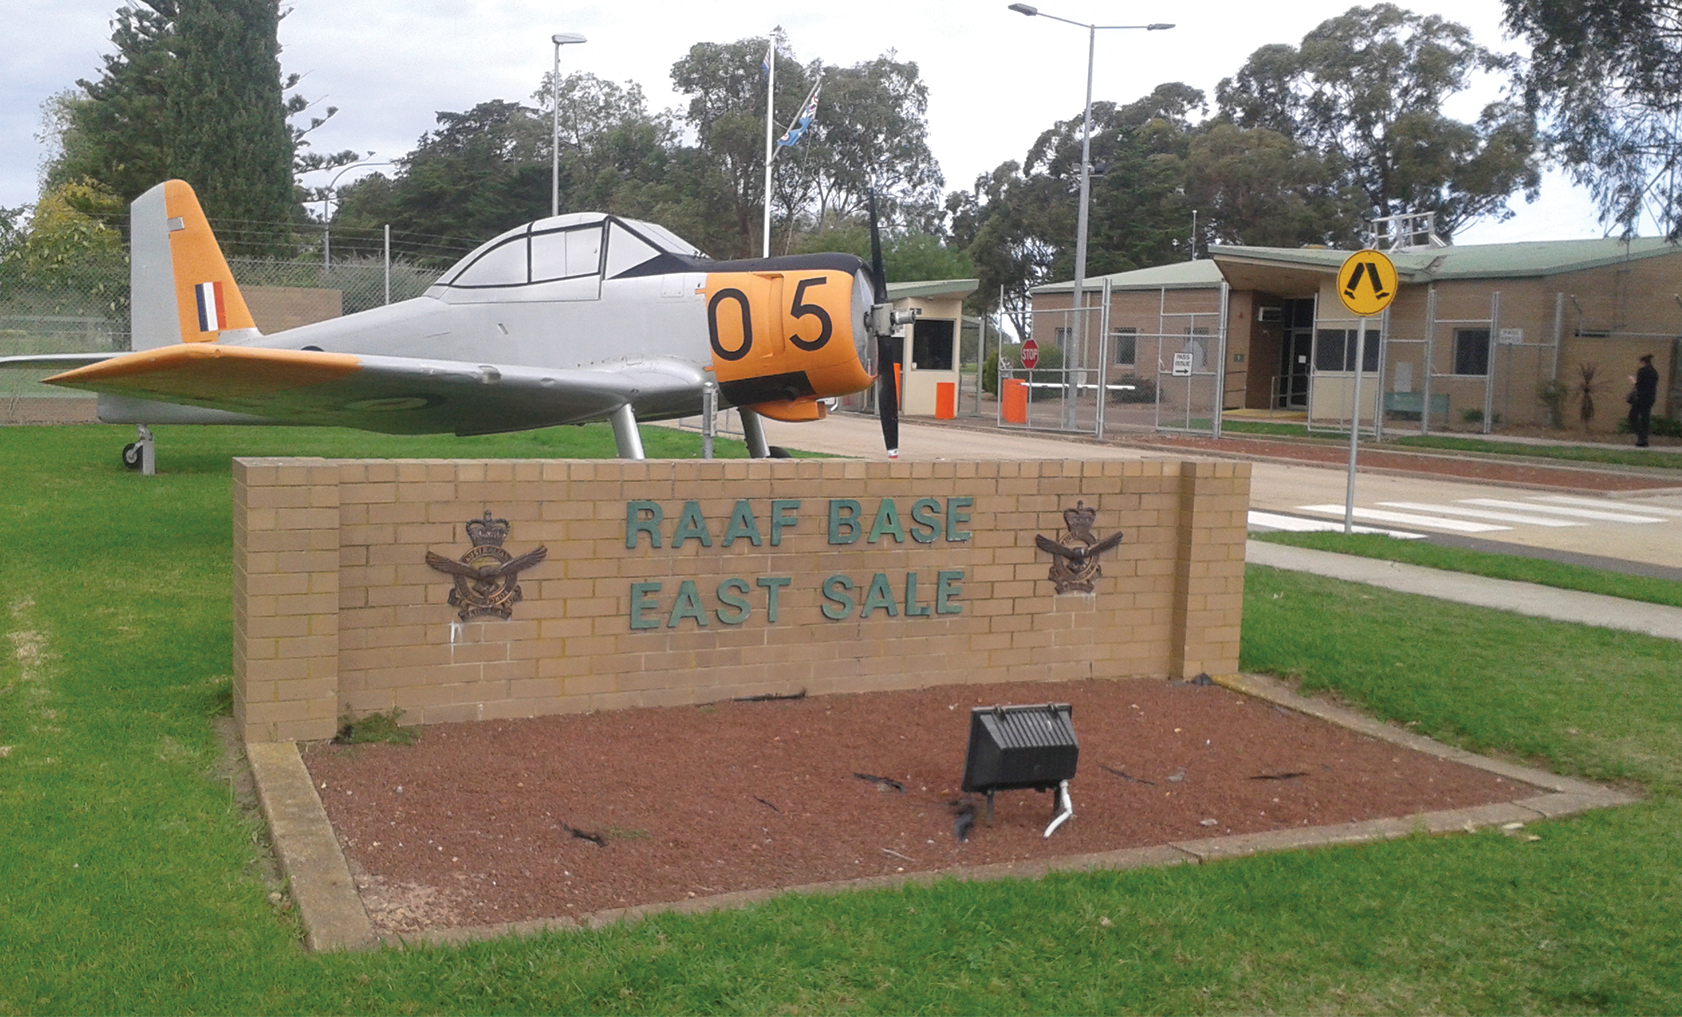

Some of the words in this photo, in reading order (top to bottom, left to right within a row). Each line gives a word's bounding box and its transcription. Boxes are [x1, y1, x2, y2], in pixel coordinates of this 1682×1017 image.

[708, 277, 832, 361] 05
[1022, 348, 1038, 361] STOP
[626, 499, 800, 548] RAAF
[828, 497, 974, 544] BASE
[630, 576, 792, 629] EAST
[821, 571, 965, 620] SALE
